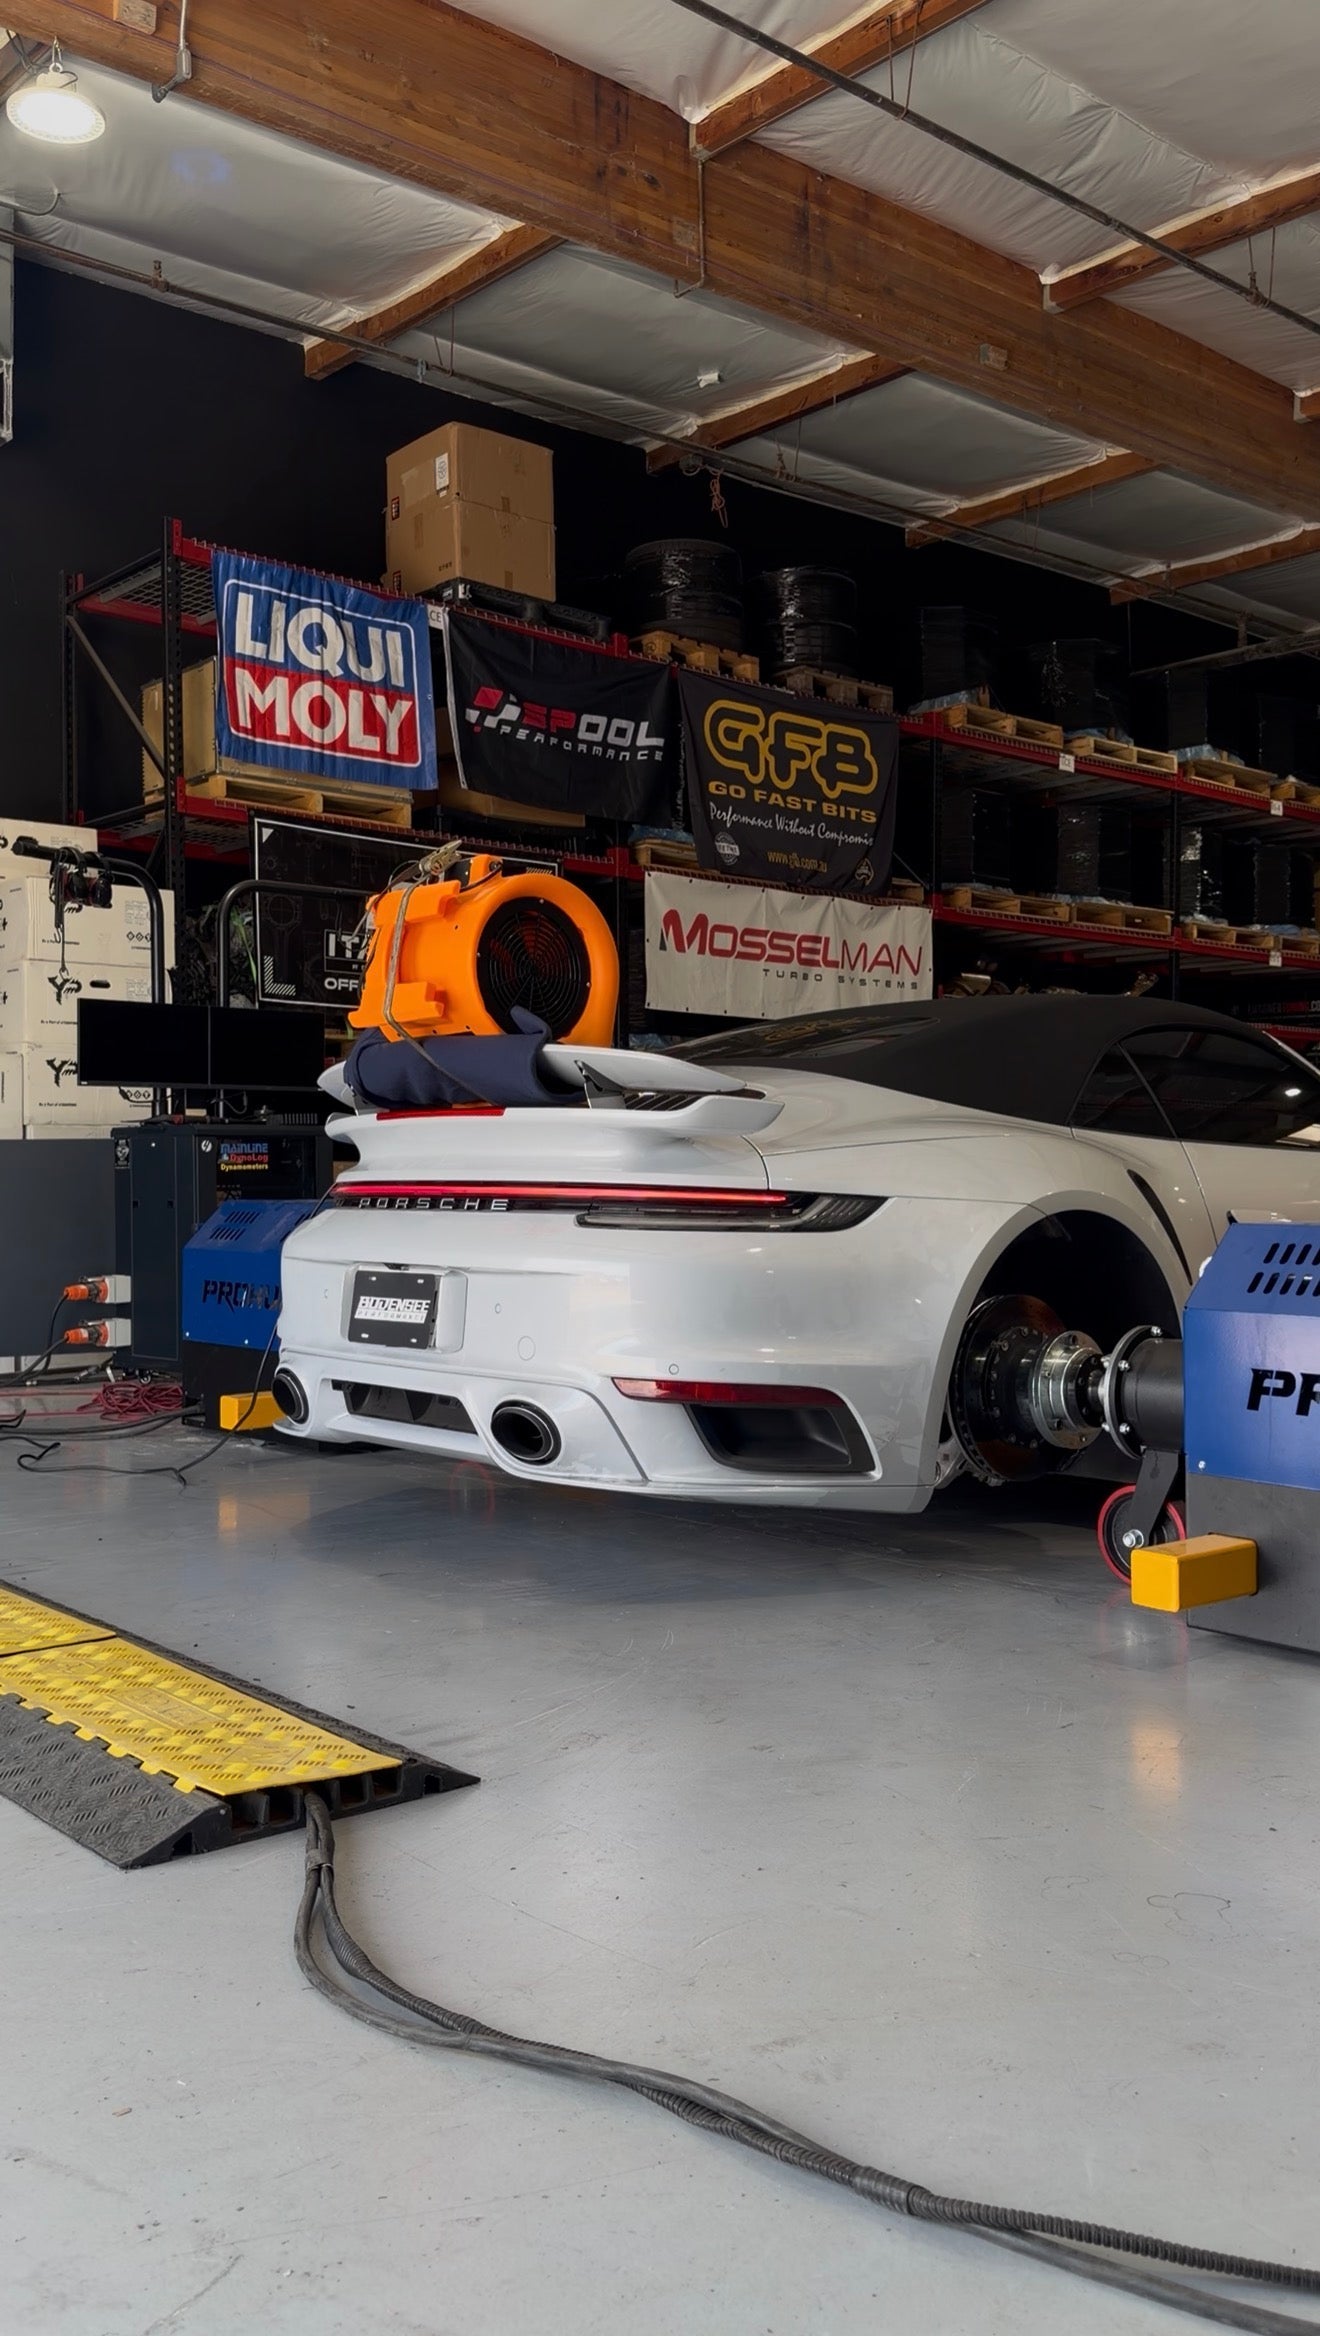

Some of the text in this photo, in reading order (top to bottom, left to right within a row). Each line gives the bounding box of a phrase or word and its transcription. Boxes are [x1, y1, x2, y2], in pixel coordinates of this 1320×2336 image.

[235, 592, 405, 688] LIQUI
[235, 667, 413, 756] MOLY
[521, 701, 665, 748] SPOOL
[500, 724, 664, 762] PERFORMANCE
[703, 699, 879, 800] GFB
[707, 780, 878, 824] GO FAST BITS
[708, 801, 773, 829] Performance
[775, 813, 815, 839] Without
[762, 968, 919, 991] TURBO SYSTEMS
[220, 1163, 269, 1172] Dynamometers
[358, 1197, 509, 1211] PORSCHE
[359, 1295, 431, 1312] BODENSEE
